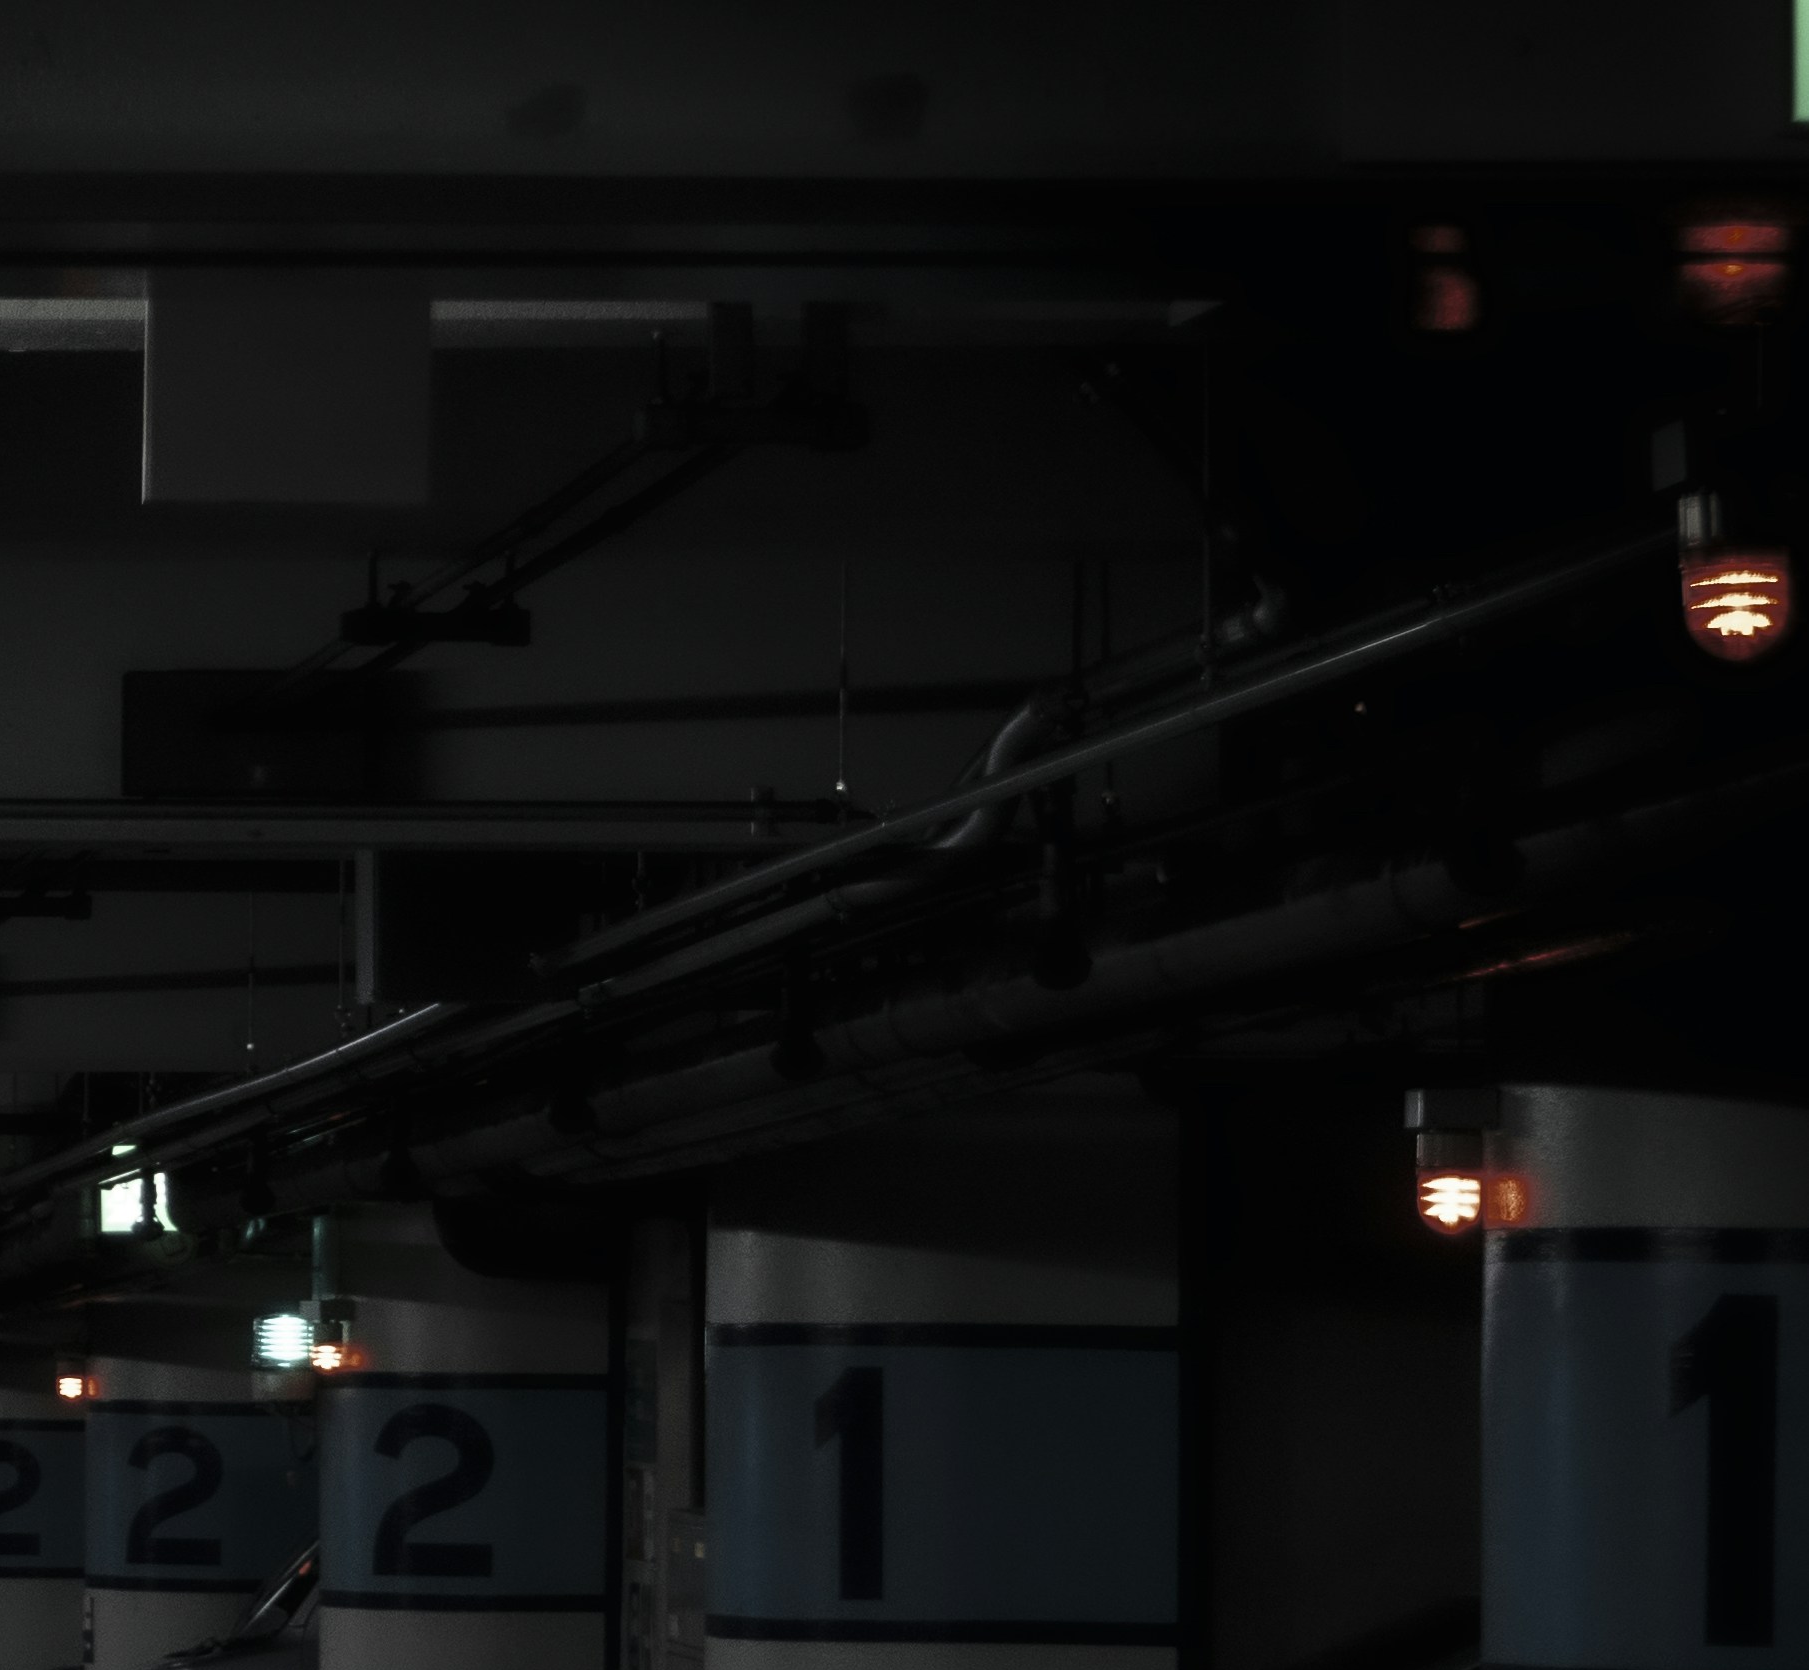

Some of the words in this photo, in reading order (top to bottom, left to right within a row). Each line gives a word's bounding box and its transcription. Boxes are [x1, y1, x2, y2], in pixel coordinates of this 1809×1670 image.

[126, 1426, 223, 1565] 2
[373, 1404, 494, 1577] 2
[815, 1367, 883, 1599] 1
[1669, 1294, 1778, 1646] 1
